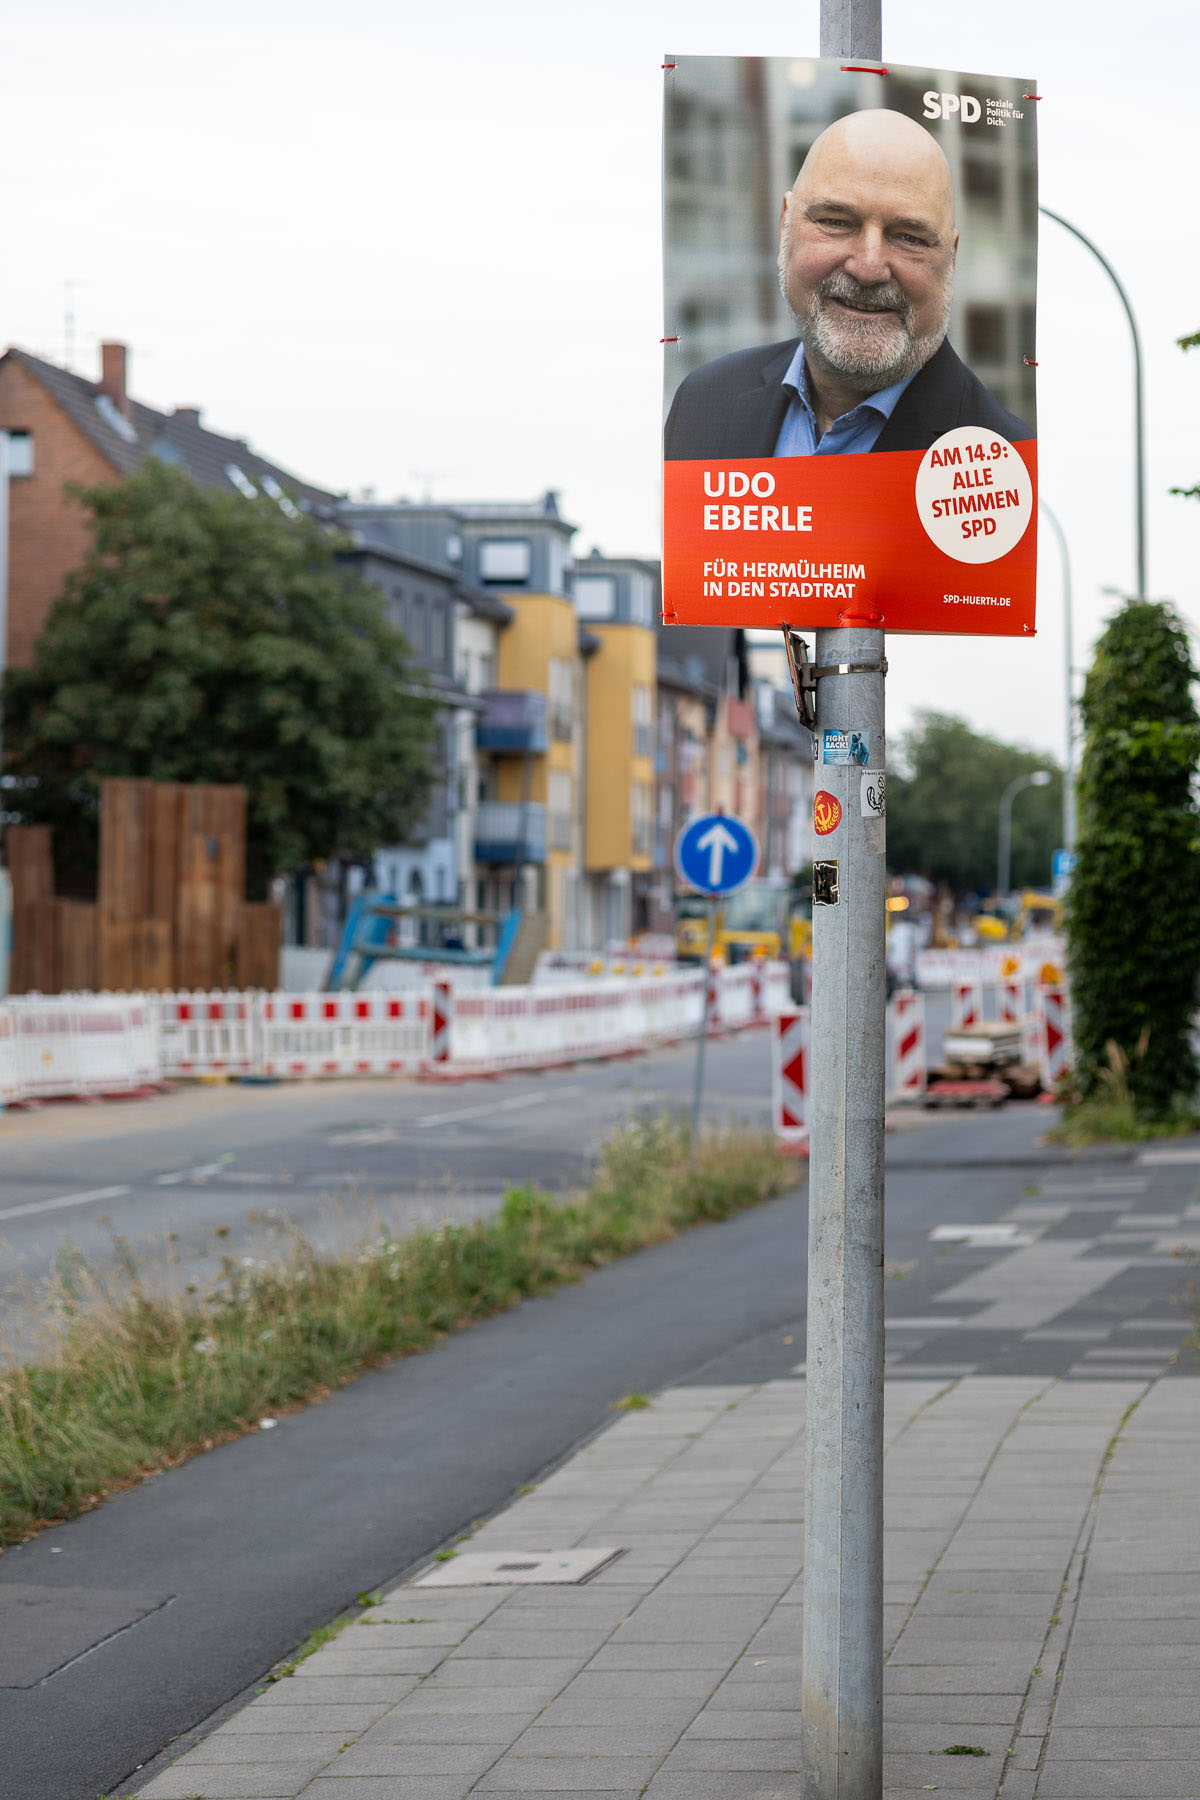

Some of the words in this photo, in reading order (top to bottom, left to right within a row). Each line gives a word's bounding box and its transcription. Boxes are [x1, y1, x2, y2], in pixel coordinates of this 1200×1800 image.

[923, 91, 981, 123] SPD
[986, 98, 1014, 109] Soziale
[986, 107, 1011, 118] Politik
[1012, 110, 1024, 119] für
[987, 117, 1006, 127] Dich.
[930, 447, 962, 468] AM
[965, 441, 1009, 463] 14.9:
[704, 471, 776, 498] UDO
[953, 468, 993, 490] ALLE
[931, 489, 1020, 518] STIMMEN
[704, 505, 813, 532] EBERLE
[961, 517, 997, 539] SPD
[703, 558, 738, 577] FÜR
[743, 559, 866, 579] HERMÜLHEIM
[703, 581, 723, 597] IN
[728, 581, 765, 597] DEN
[769, 582, 856, 599] STADTRAT
[943, 594, 1011, 607] SPD-HUERTH.DE
